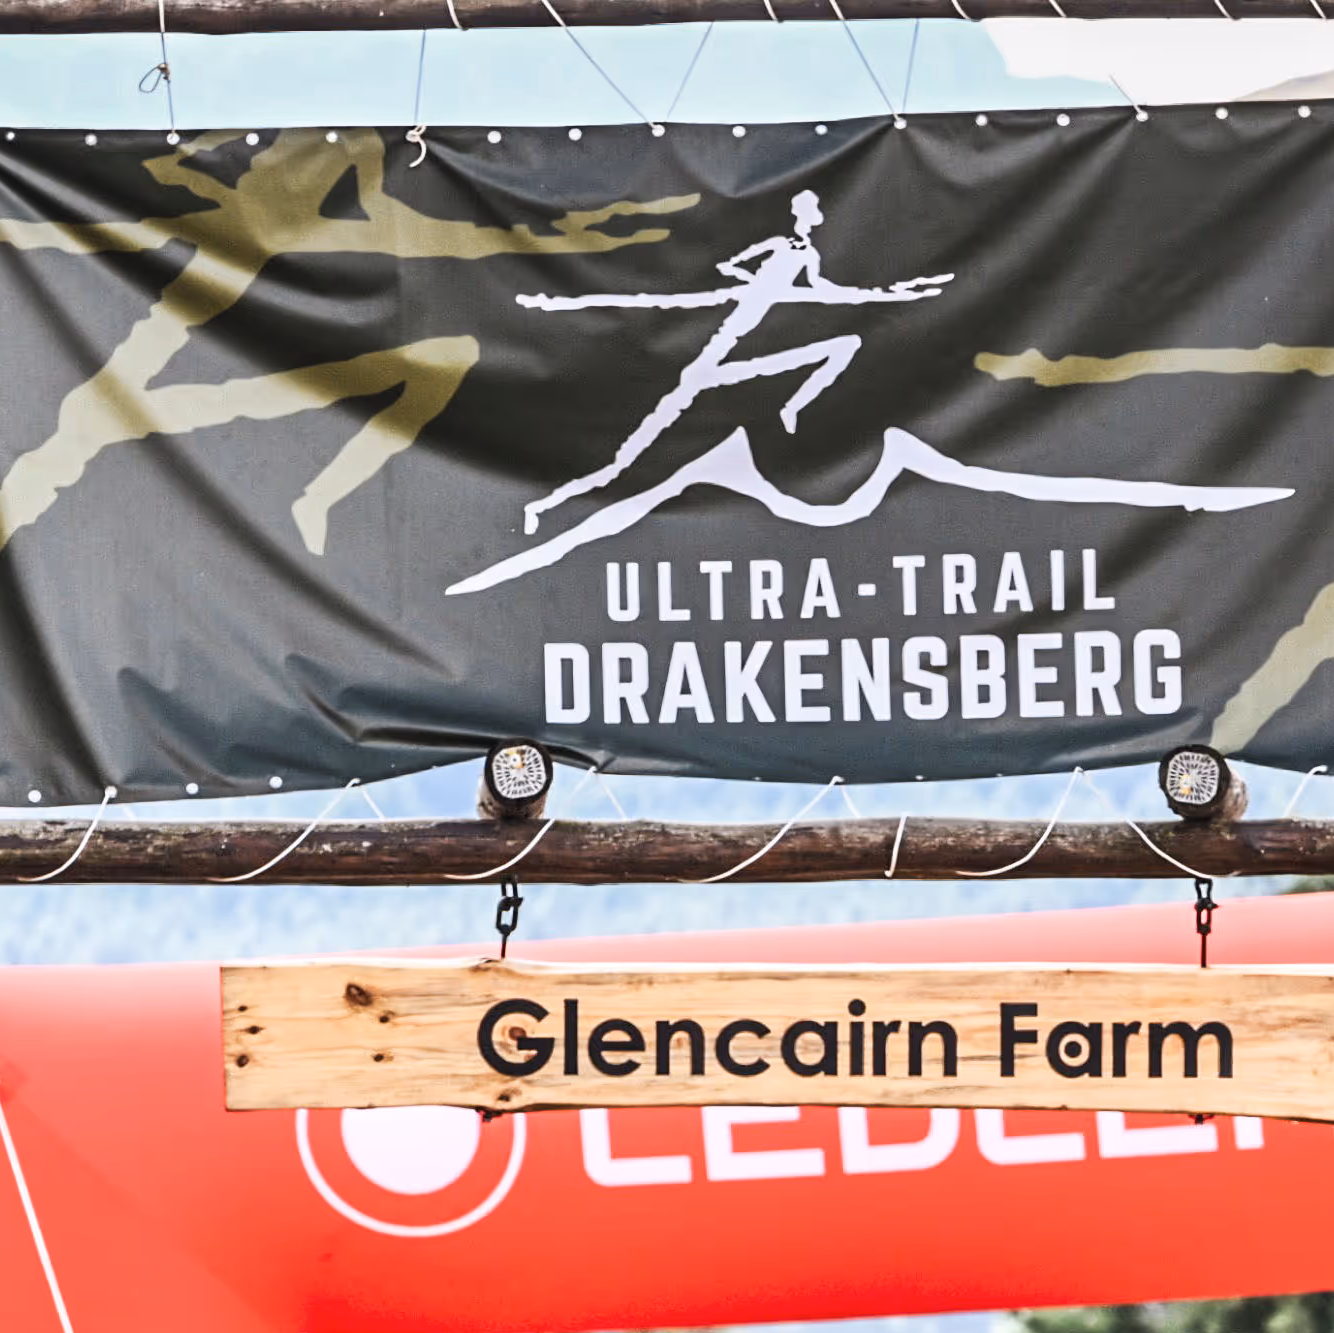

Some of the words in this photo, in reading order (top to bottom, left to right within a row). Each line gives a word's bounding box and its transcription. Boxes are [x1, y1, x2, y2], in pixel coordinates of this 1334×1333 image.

[605, 548, 1116, 623] ULTRA-TRAIL
[543, 629, 1183, 725] DRAKENSBERG
[478, 998, 958, 1078] Glencairn
[1000, 1001, 1234, 1079] Farm
